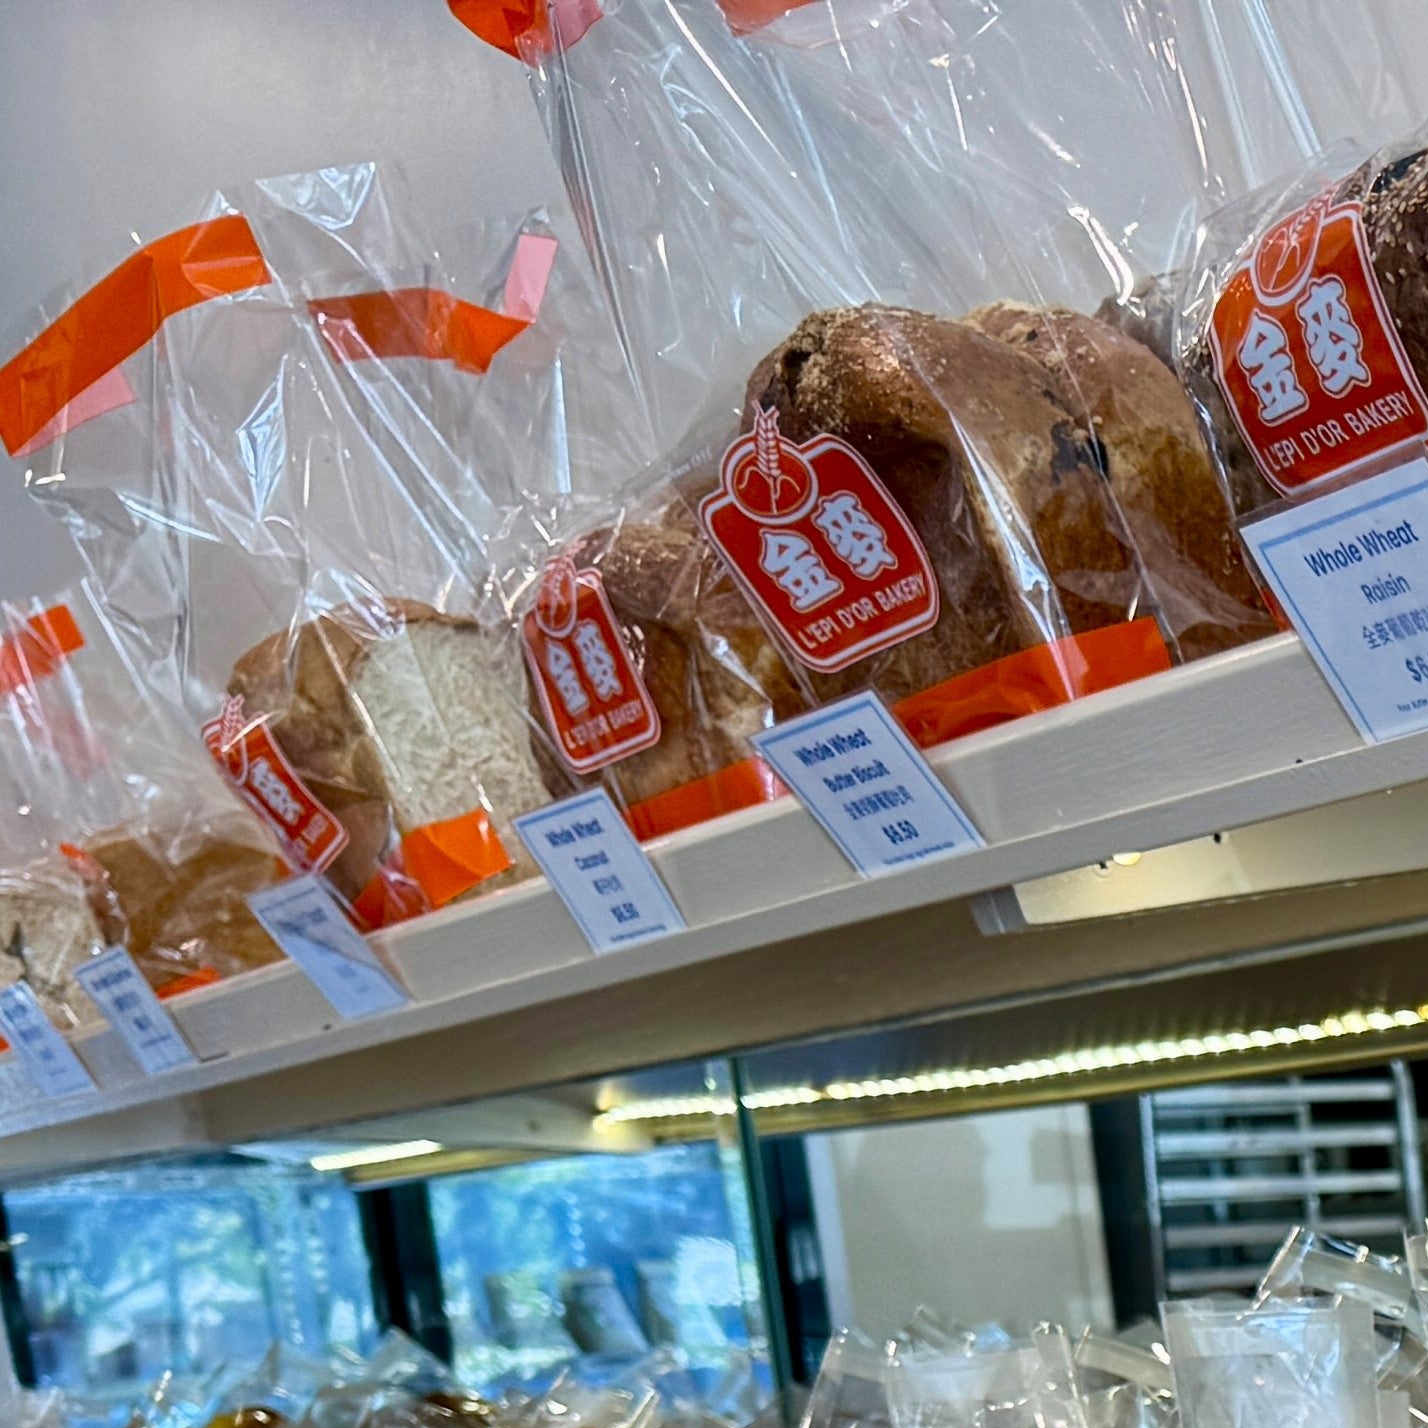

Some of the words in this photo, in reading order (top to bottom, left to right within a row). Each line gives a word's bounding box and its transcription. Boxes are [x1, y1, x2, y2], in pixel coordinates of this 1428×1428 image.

[1264, 433, 1303, 472] L'EPI
[1301, 417, 1349, 453] D'OR
[1349, 390, 1416, 437] BAKERY
[1303, 542, 1361, 578] Whole
[1359, 518, 1419, 558] Wheat
[798, 614, 840, 649] L'EPI
[839, 597, 878, 630] D'OR
[877, 573, 926, 612] BAKERY
[1360, 574, 1411, 604] Raisin
